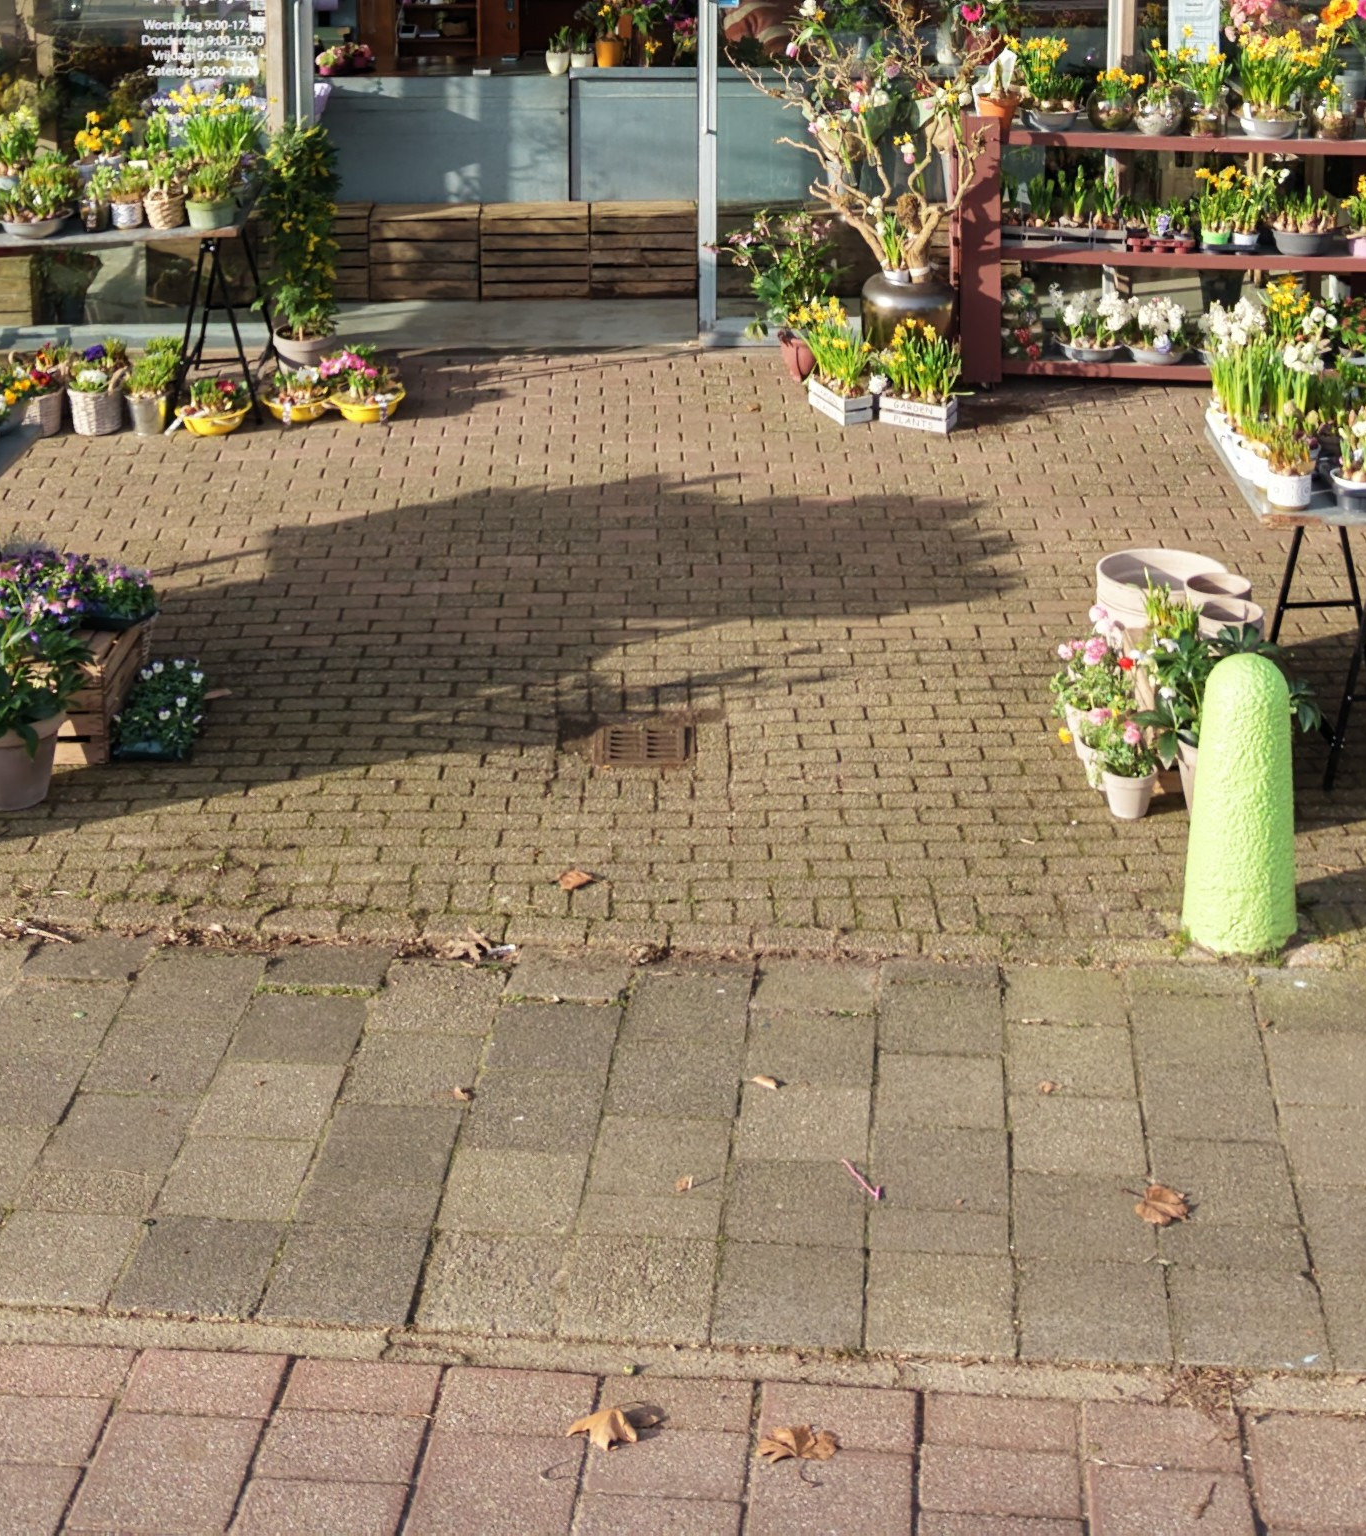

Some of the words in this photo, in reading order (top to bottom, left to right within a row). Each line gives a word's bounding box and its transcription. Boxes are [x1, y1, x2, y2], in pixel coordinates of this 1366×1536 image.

[143, 19, 202, 32] Woensdag
[141, 35, 204, 47] Donderdag
[206, 35, 264, 46] 9:00-17:30
[152, 50, 195, 63] Vrijdag:
[196, 50, 254, 61] 9:00-17:30
[146, 65, 200, 78] Zaterdag:
[893, 401, 933, 415] GARDEN
[893, 415, 934, 430] PLANTS
